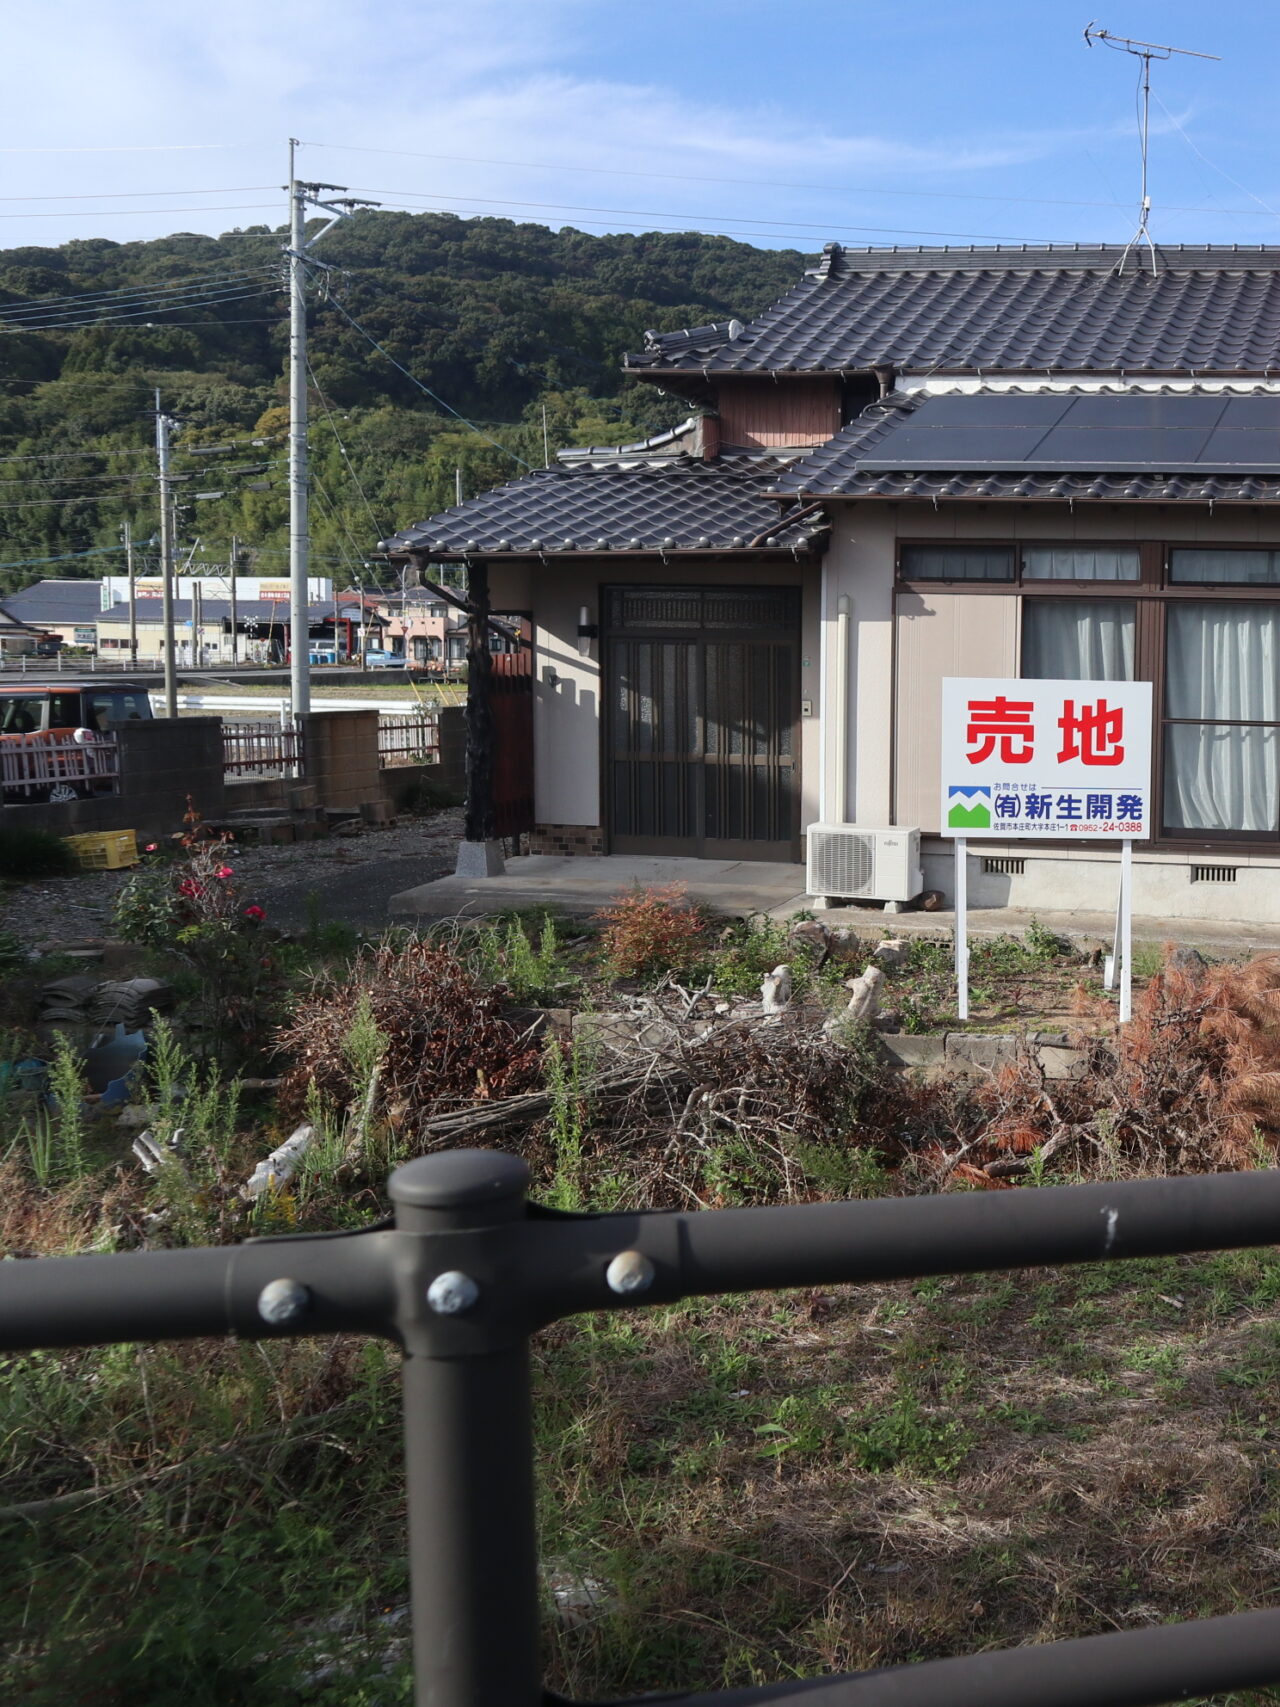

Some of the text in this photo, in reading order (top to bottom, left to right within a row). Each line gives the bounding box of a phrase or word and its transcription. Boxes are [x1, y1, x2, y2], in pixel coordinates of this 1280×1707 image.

[966, 696, 1125, 766] 売地
[993, 782, 1037, 791] お問合せは
[1078, 822, 1142, 832] 0952-24-0388
